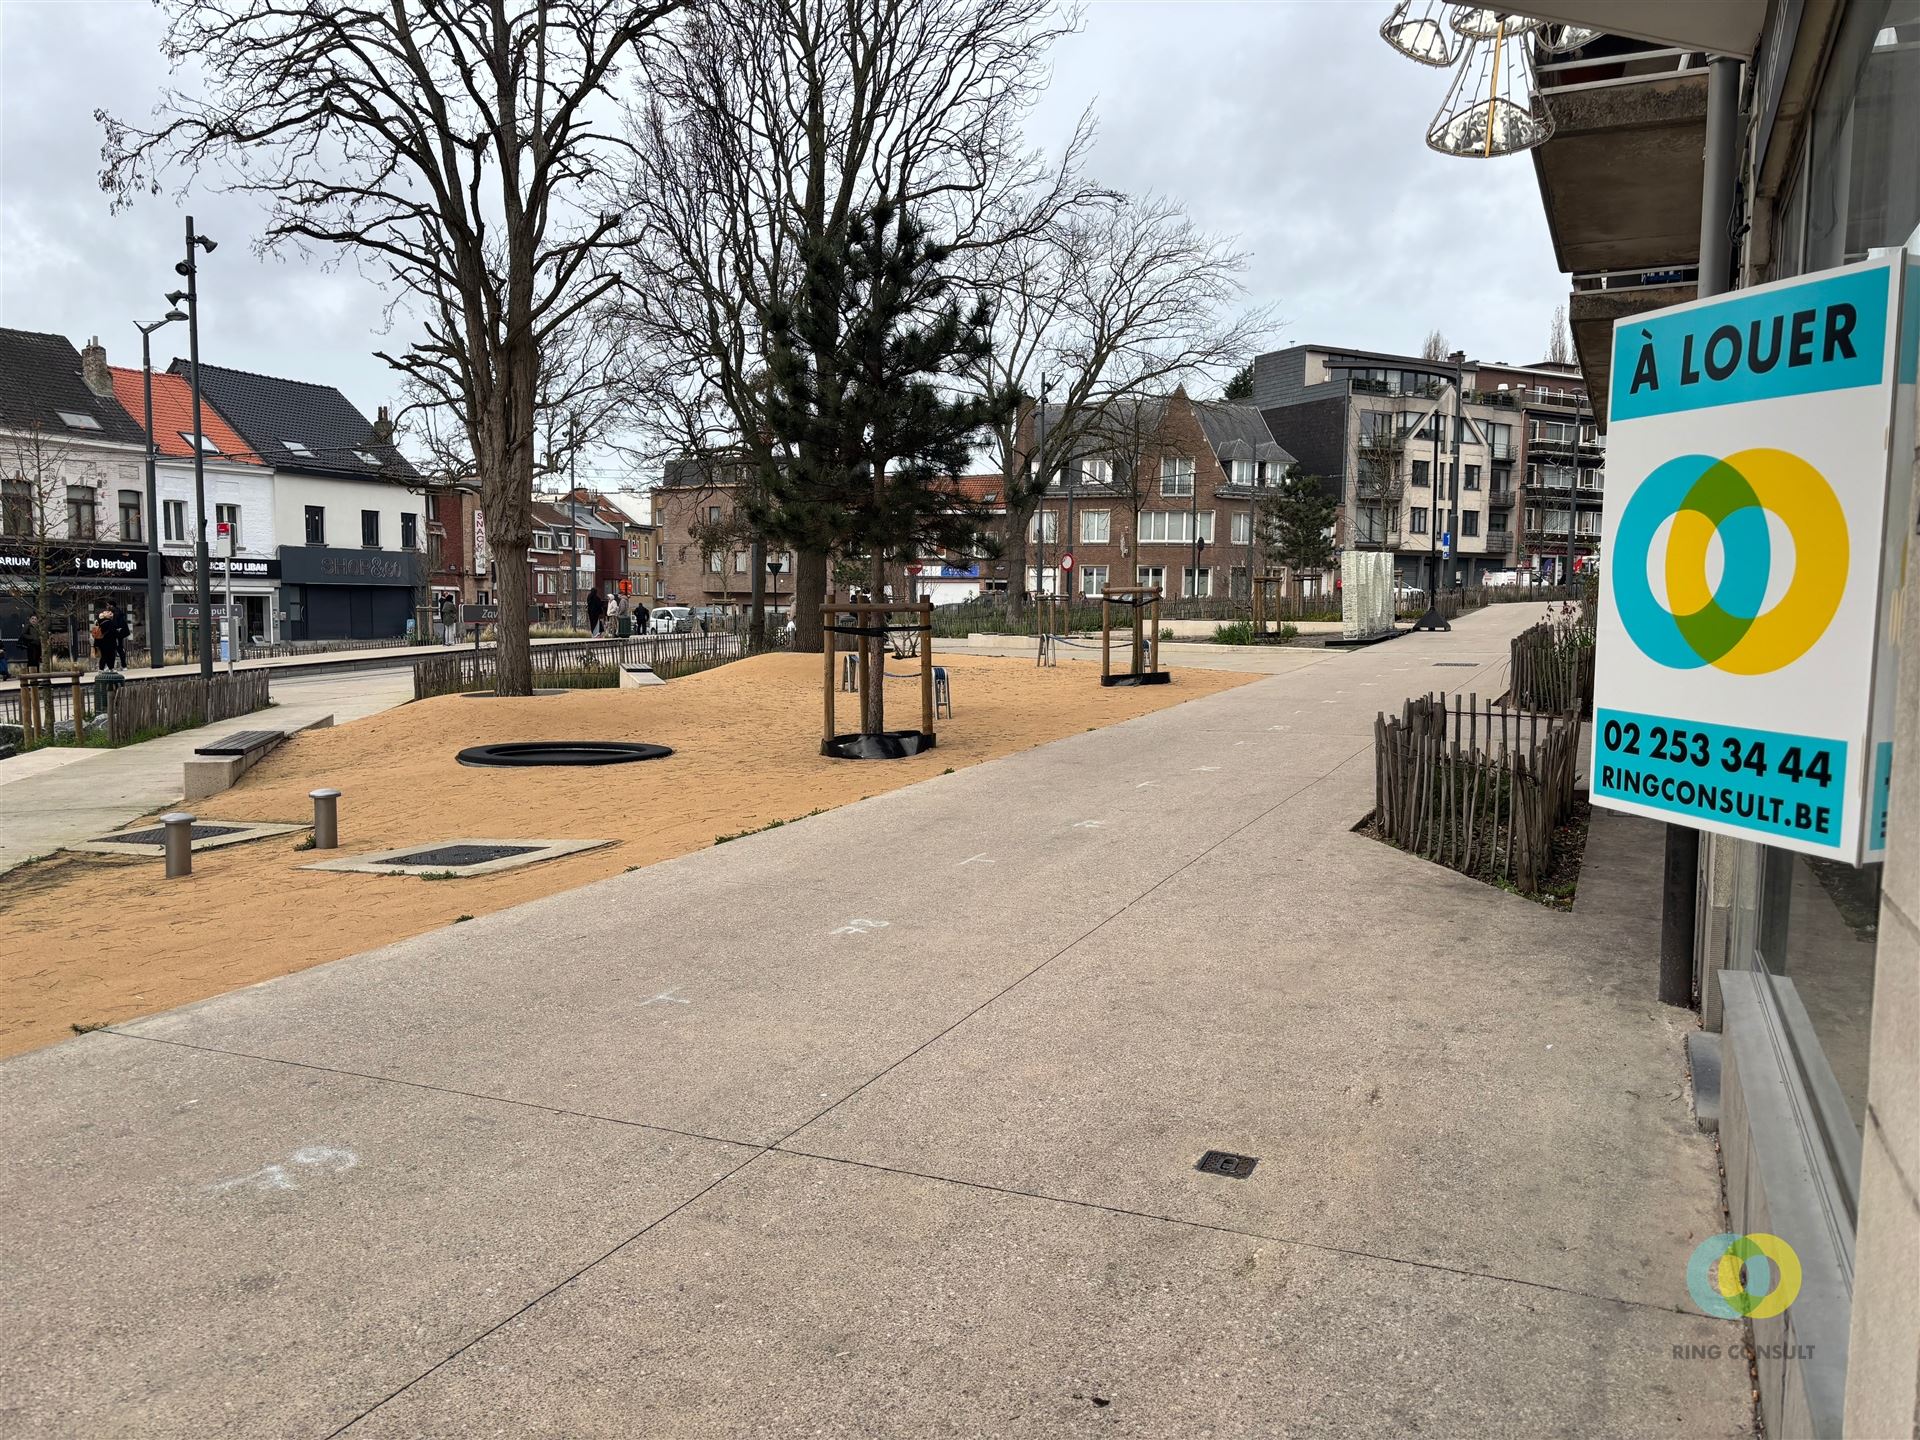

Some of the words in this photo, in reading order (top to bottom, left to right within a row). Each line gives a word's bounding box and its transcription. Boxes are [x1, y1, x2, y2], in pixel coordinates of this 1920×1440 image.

[1629, 328, 1659, 395] À
[1680, 303, 1857, 386] LOUER
[476, 512, 485, 550] SNACK
[87, 558, 99, 568] De
[101, 558, 137, 571] Hertogh
[230, 562, 242, 571] DU
[188, 607, 226, 617] Zaput
[1604, 720, 1640, 755] 02
[1649, 726, 1710, 767] 253
[1721, 738, 1767, 777] 34
[1777, 747, 1832, 788] 44
[1602, 765, 1830, 834] RINGCONSULT.BE
